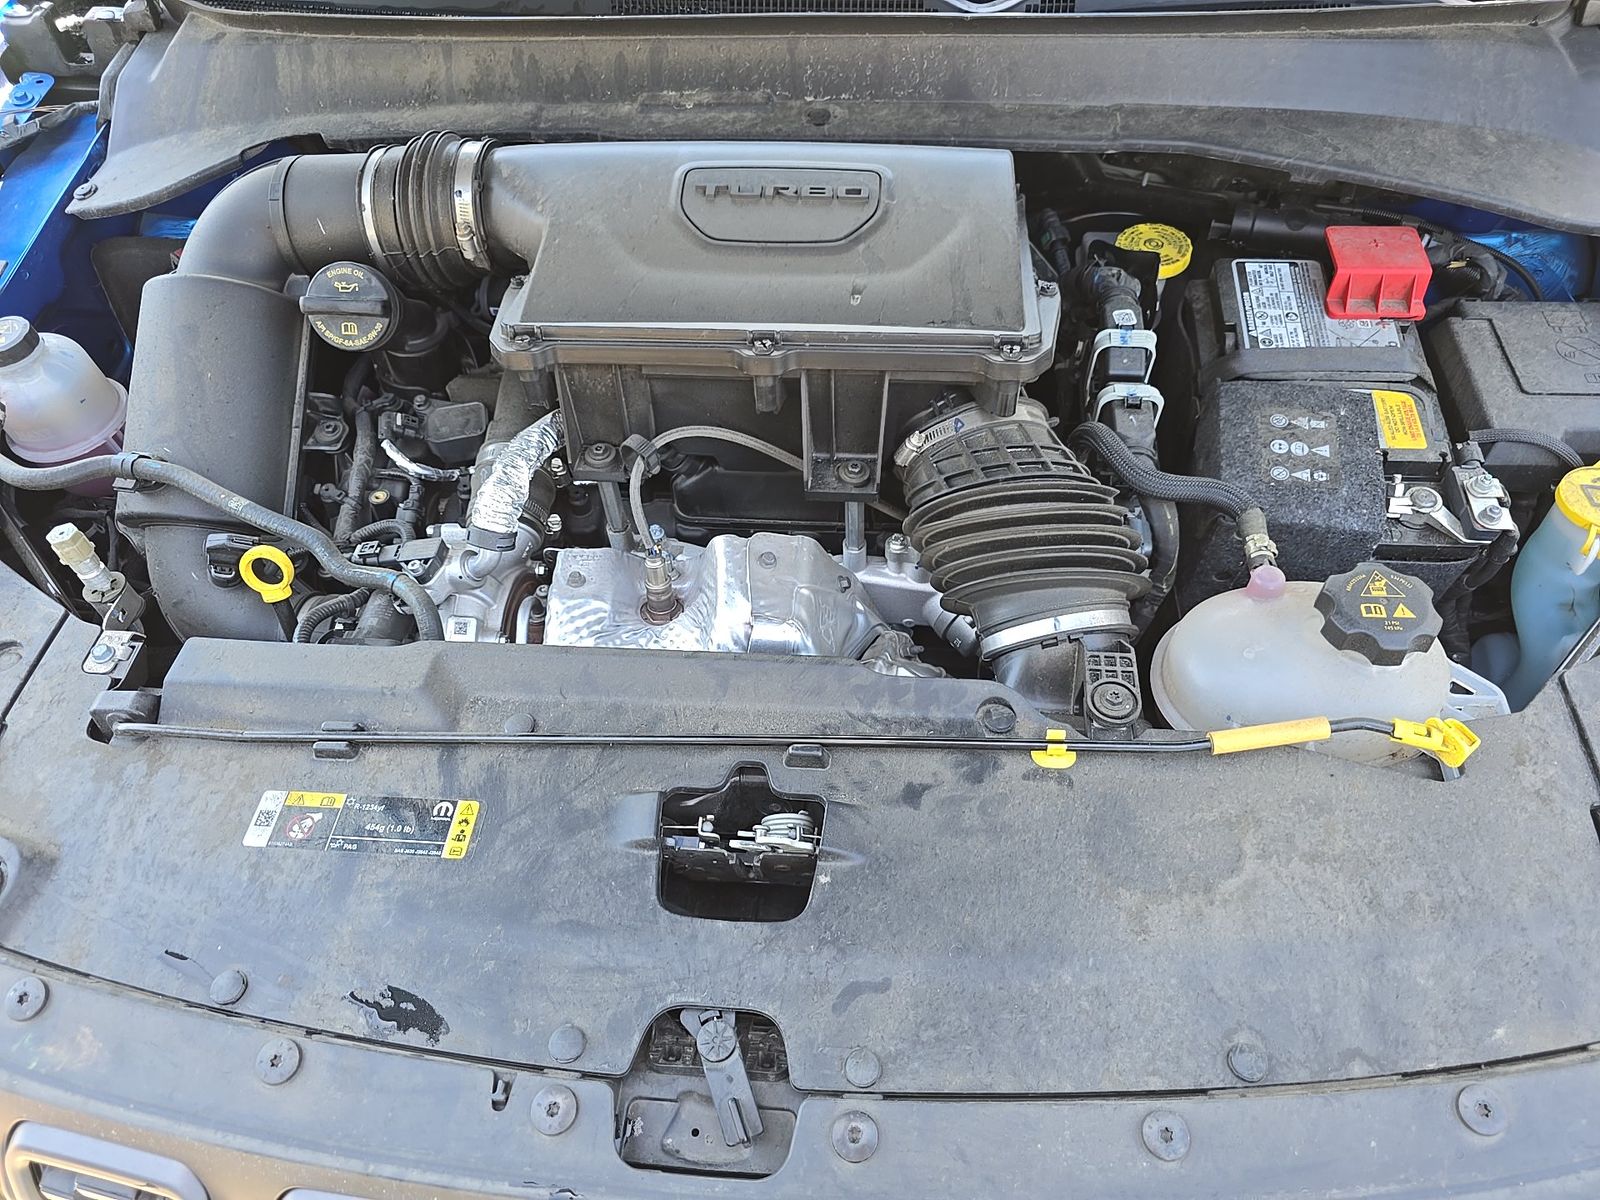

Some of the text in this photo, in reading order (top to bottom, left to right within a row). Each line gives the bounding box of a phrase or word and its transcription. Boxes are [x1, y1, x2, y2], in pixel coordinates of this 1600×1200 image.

[695, 184, 869, 202] TURBO
[326, 267, 364, 280] ENGINE OIL
[316, 320, 327, 332] API
[365, 823, 415, 835] 454g (1.0 lb)
